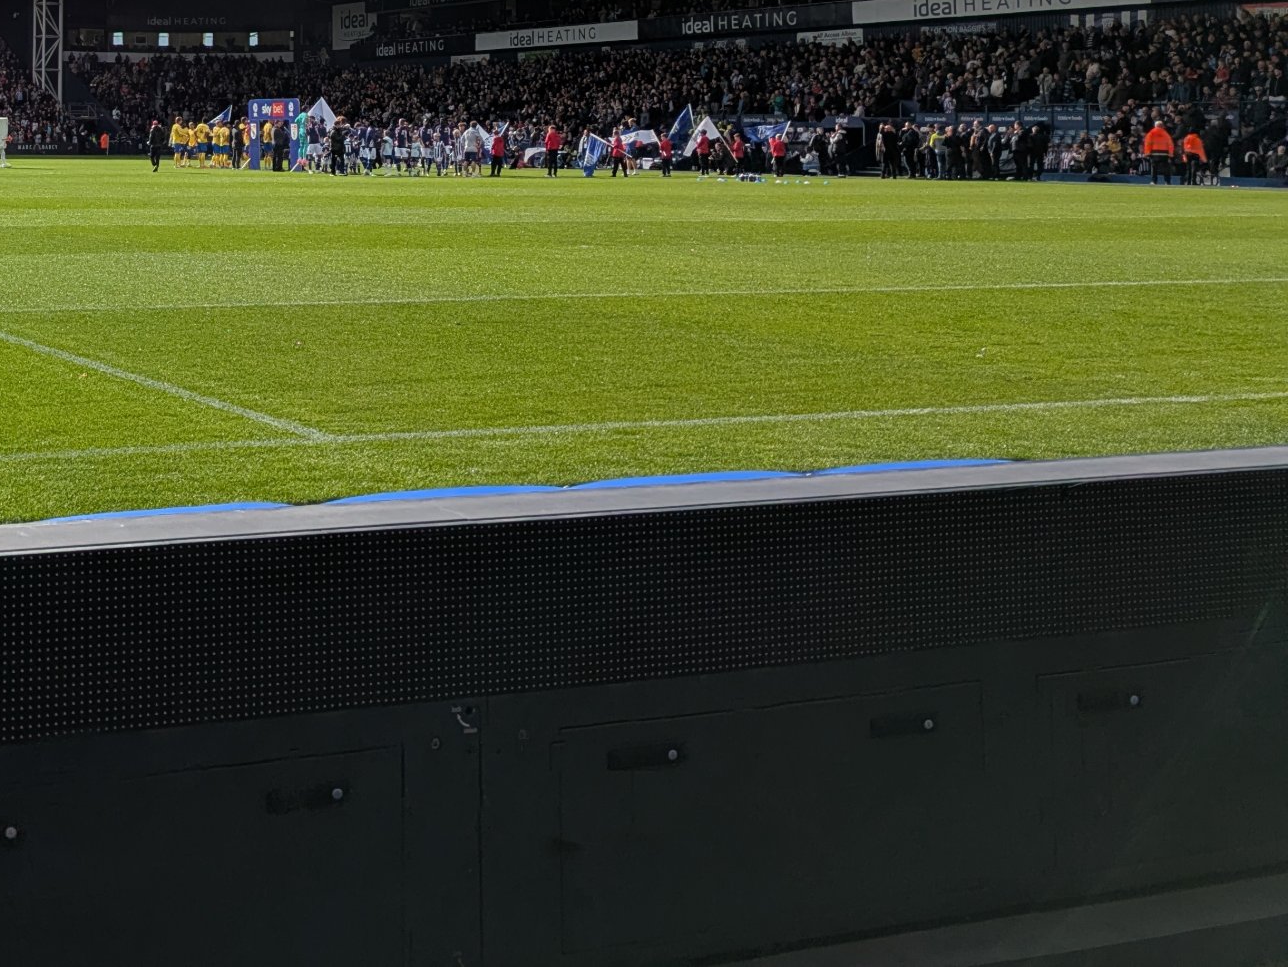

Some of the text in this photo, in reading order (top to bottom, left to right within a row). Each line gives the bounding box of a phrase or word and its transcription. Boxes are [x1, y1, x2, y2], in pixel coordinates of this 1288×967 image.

[147, 16, 227, 26] ideal HEATING
[340, 9, 368, 29] ideal
[681, 10, 798, 35] ideal HEATING
[510, 27, 596, 47] ideal HEATING
[376, 39, 445, 57] ideal HEATING
[261, 103, 283, 117] sky bet
